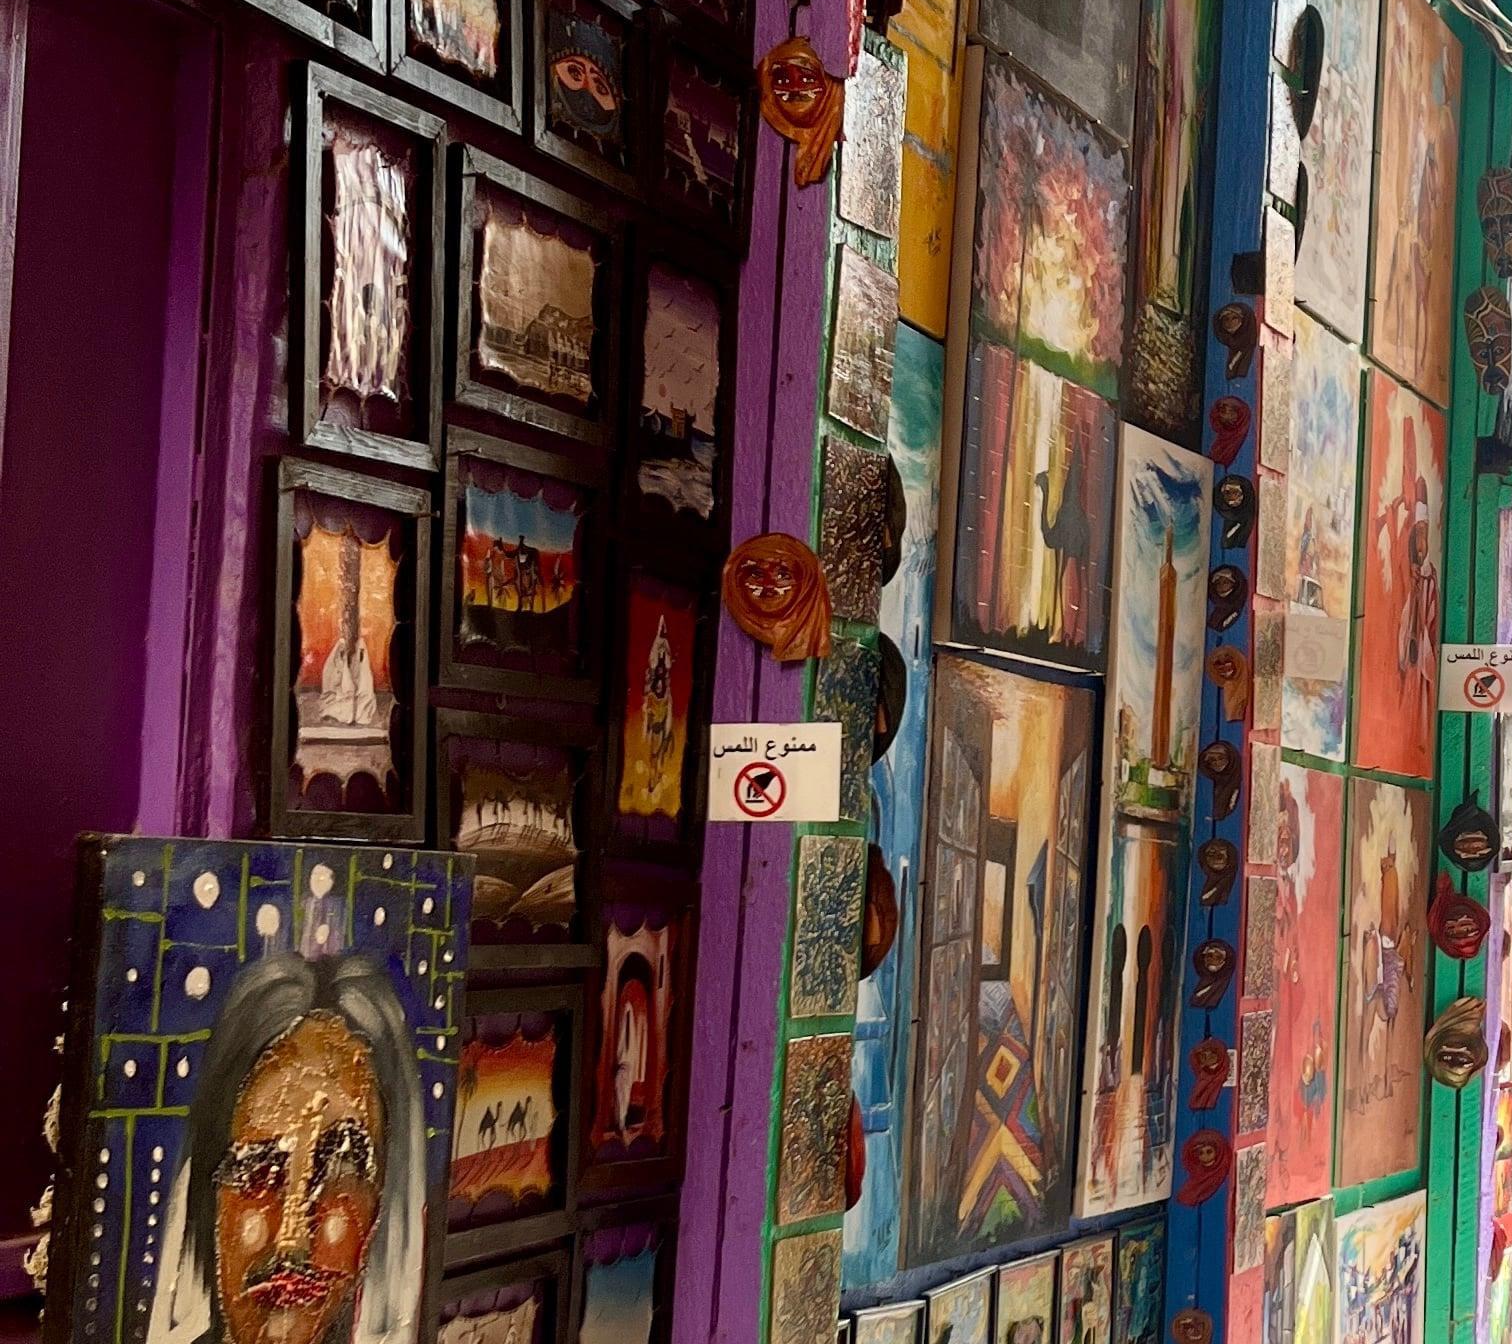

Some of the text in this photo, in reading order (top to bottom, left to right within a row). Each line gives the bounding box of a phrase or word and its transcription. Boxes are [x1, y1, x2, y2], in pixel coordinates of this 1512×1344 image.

[1446, 648, 1485, 663] اللمس
[713, 736, 817, 760] ممنوع اللمس
